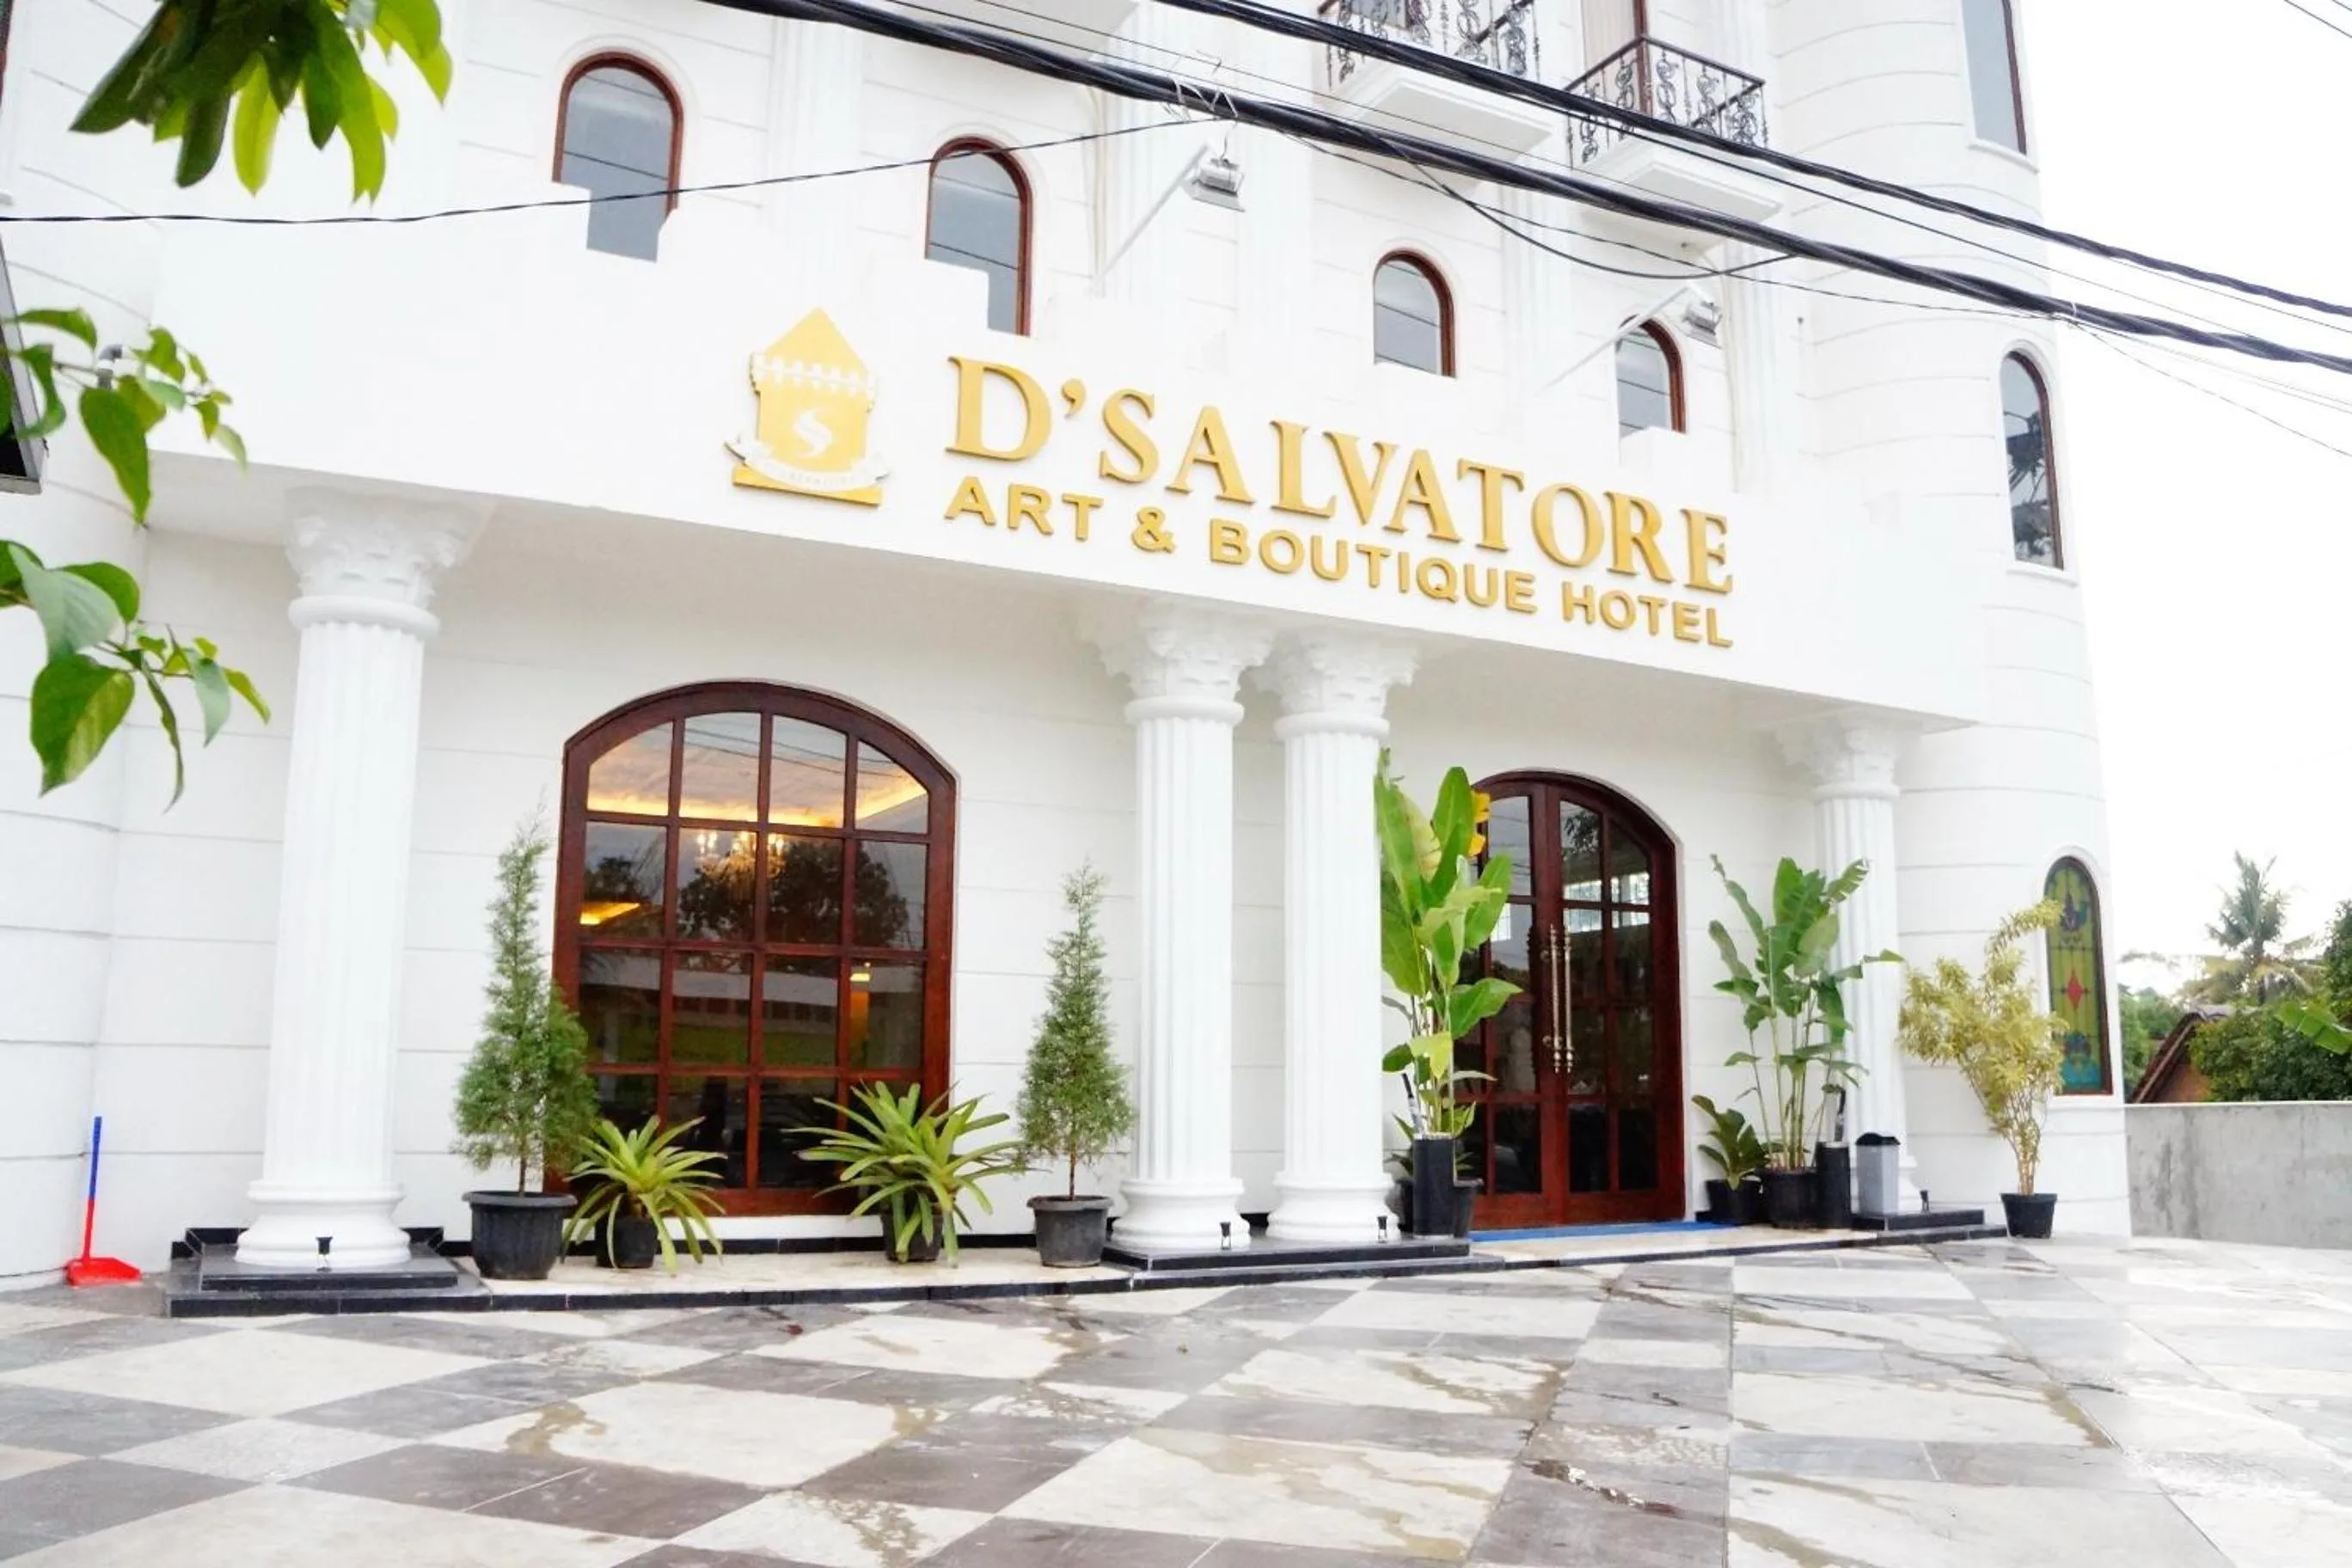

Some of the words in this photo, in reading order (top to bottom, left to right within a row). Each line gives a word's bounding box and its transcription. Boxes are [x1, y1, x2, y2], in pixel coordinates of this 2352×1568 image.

[944, 475, 1105, 542] ART
[1130, 505, 1177, 554] &
[1209, 518, 1537, 615] BOUTIQUE
[1560, 581, 1732, 648] HOTEL
[945, 355, 1734, 595] D'SALVATORE
